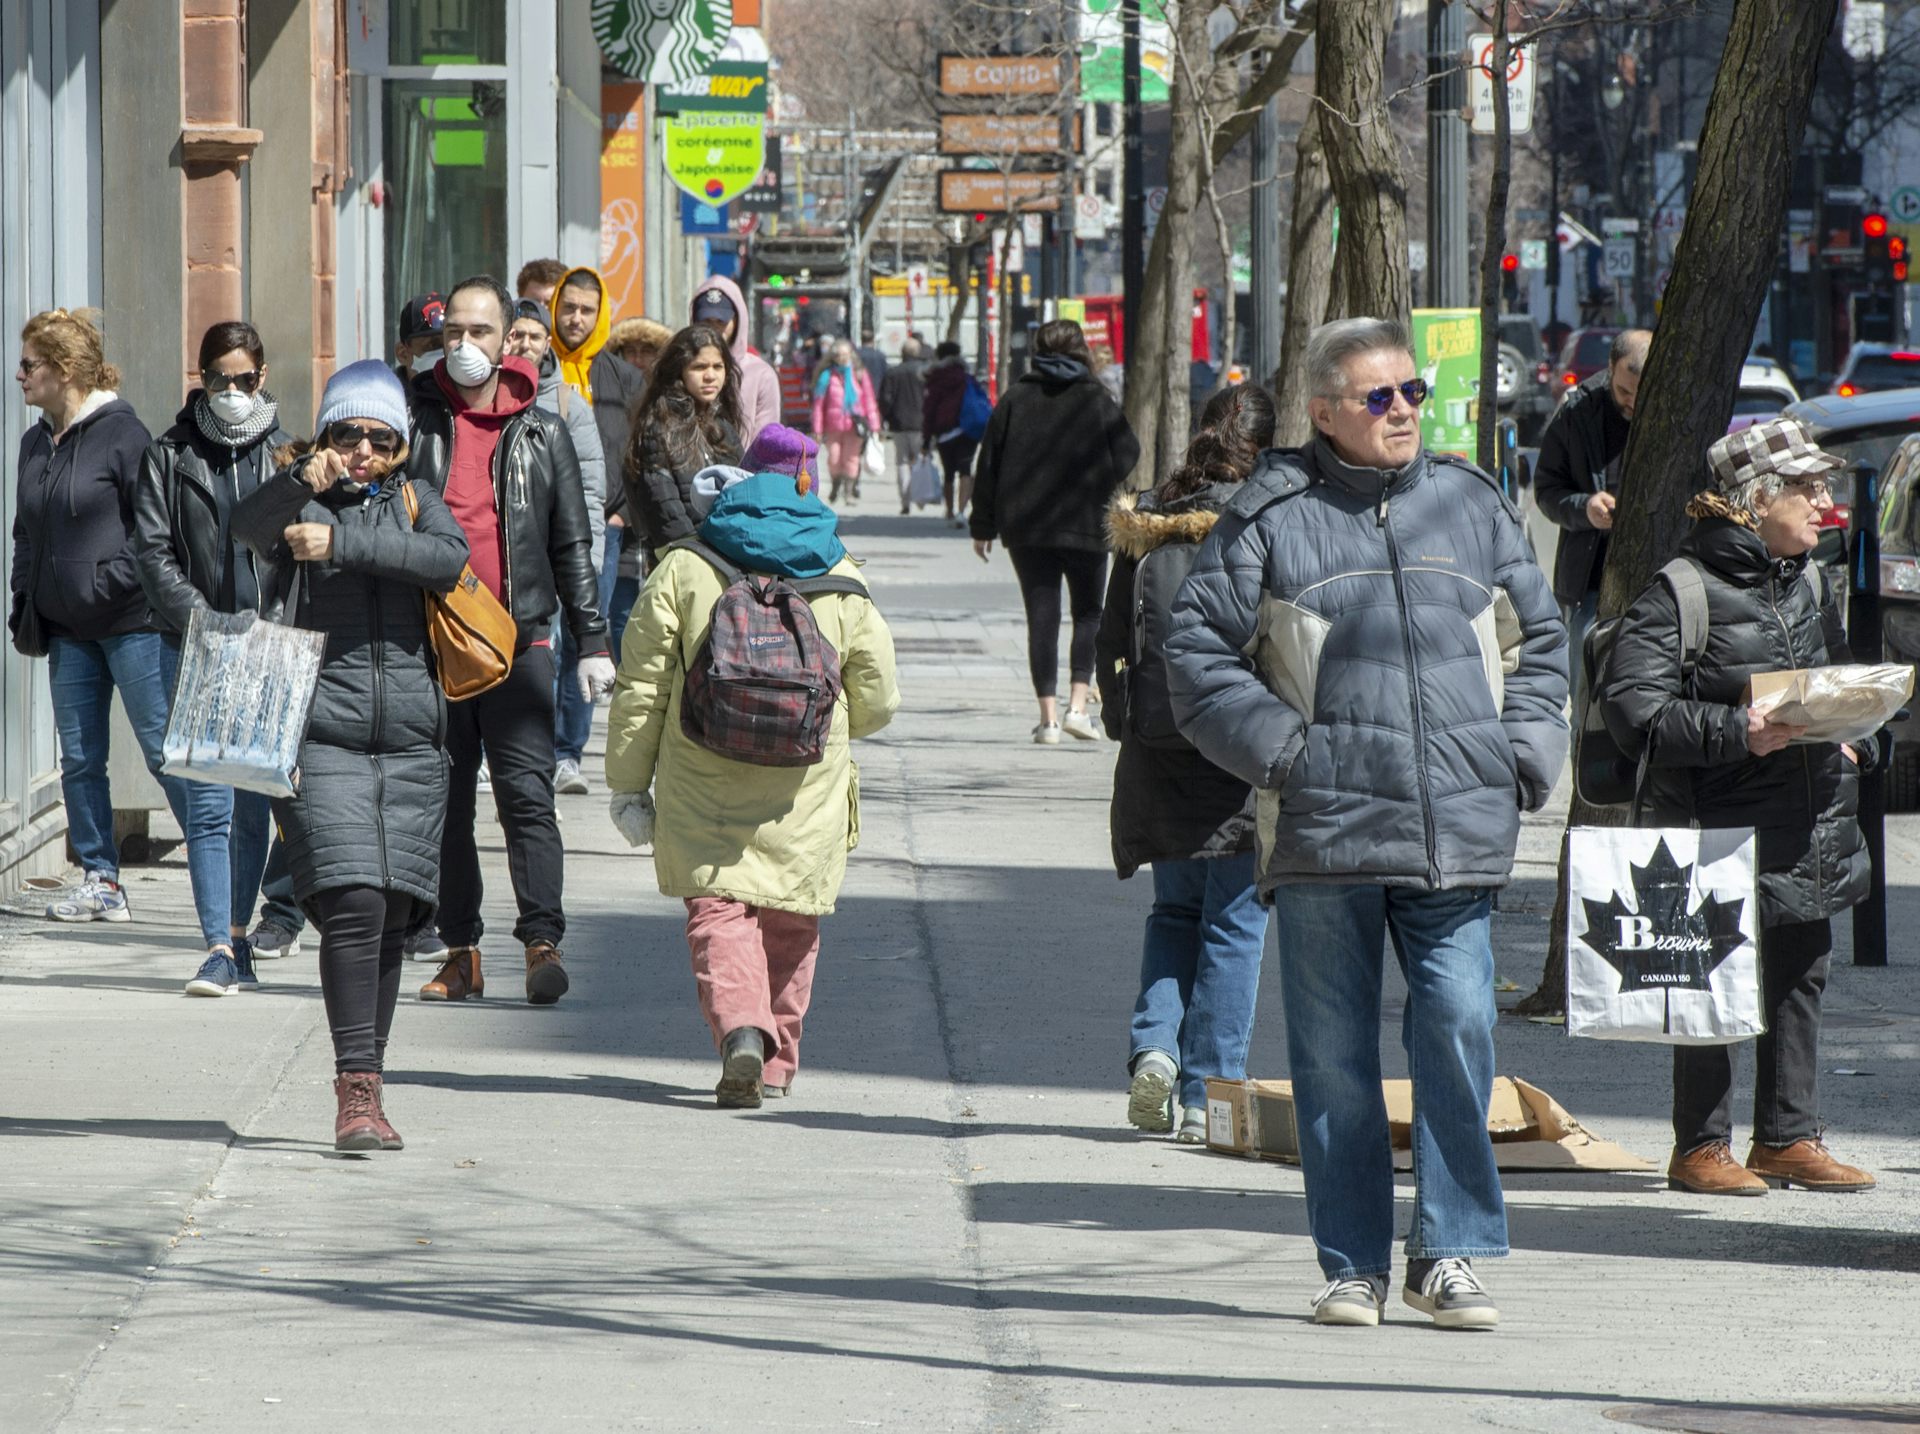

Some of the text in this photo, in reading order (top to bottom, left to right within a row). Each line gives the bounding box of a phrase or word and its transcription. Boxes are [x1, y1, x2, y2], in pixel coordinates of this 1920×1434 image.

[974, 64, 1061, 85] COVID-1
[662, 74, 765, 98] SUBWAY
[1607, 249, 1632, 270] 50
[1614, 914, 1713, 952] Browns
[1640, 973, 1691, 984] CANADA 150
